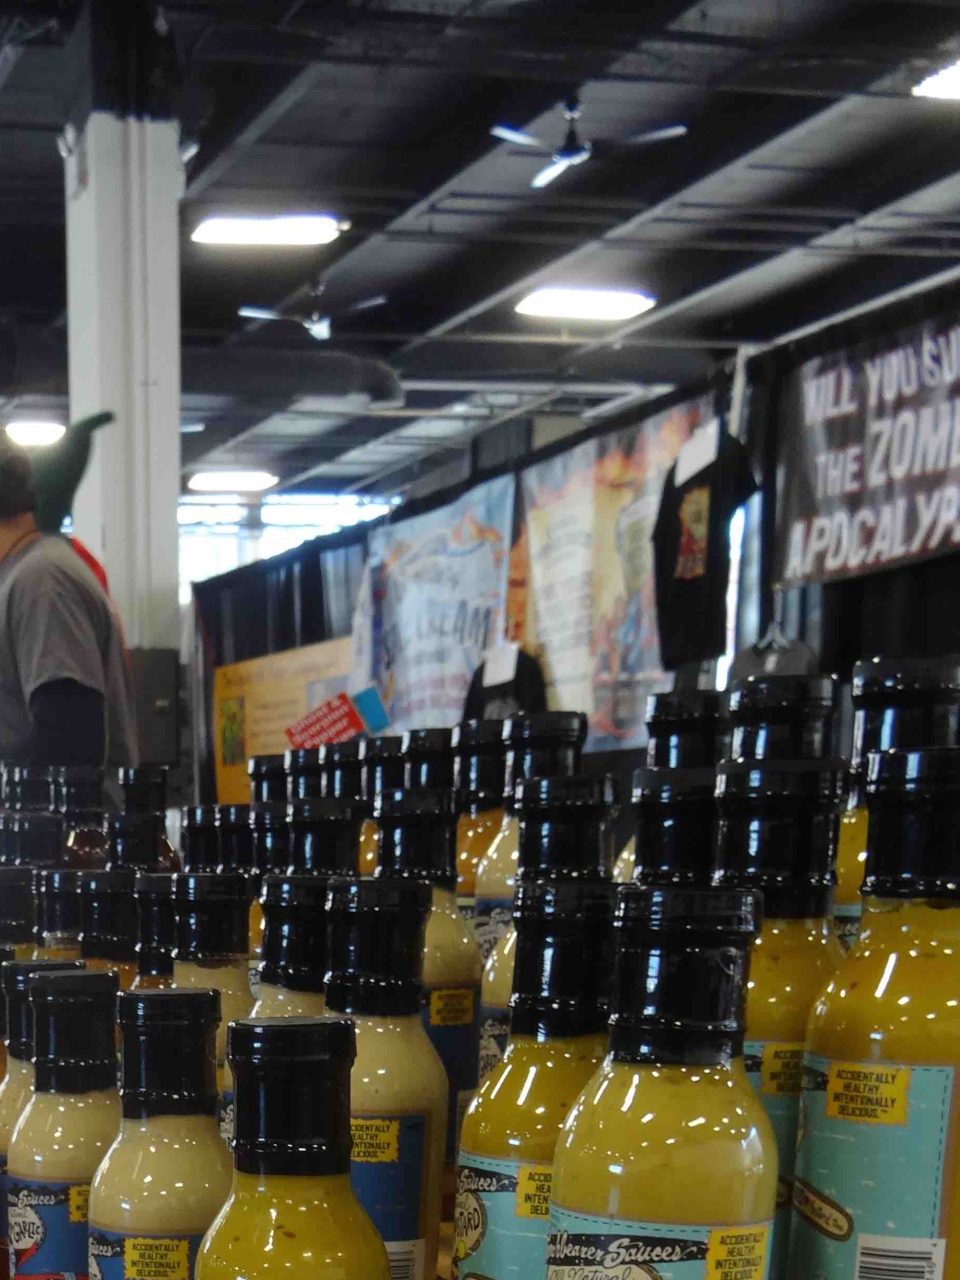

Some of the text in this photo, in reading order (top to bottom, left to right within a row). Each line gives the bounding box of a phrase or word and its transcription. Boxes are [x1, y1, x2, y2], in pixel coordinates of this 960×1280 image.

[864, 346, 919, 408] YOU
[815, 398, 960, 500] THE ZOM
[132, 1243, 181, 1252] ACCIDENTALLY
[602, 1237, 684, 1269] Sauces
[130, 1261, 181, 1269] INTENTIONALLY
